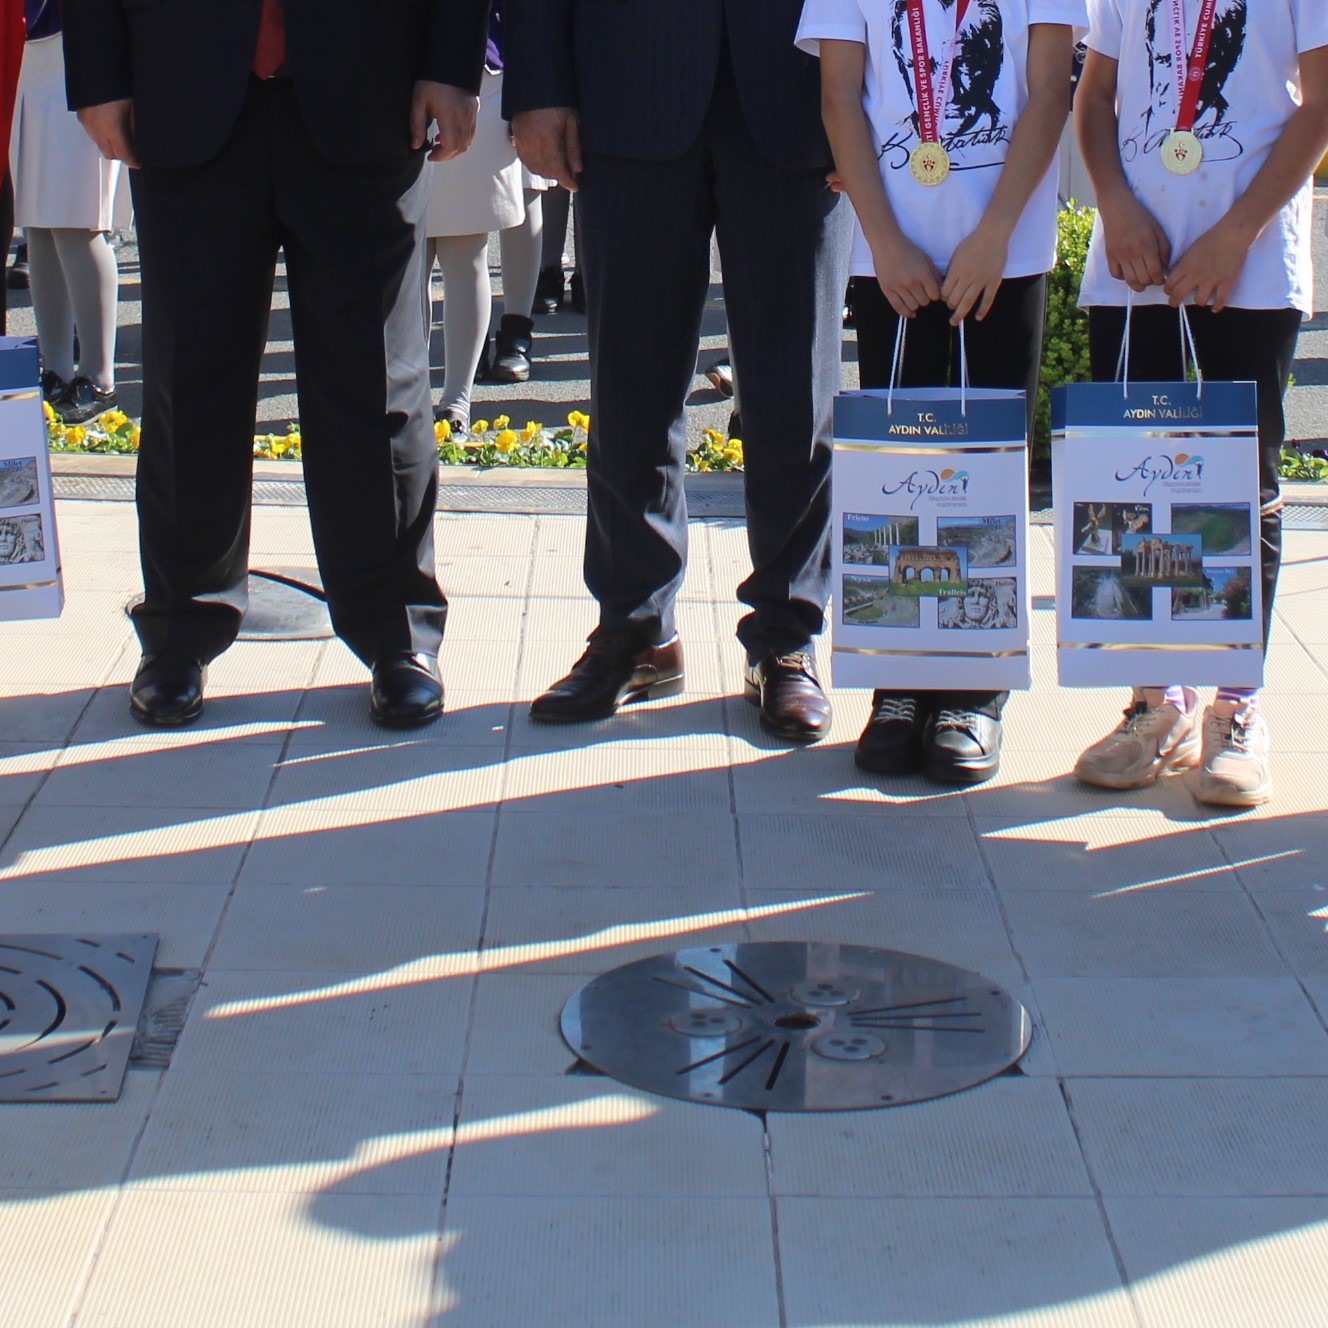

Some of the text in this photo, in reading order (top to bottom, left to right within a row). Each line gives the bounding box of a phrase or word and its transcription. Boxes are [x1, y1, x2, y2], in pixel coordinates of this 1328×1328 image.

[1173, 26, 1182, 37] VE
[1195, 23, 1210, 59] TÜRKİYE
[1174, 38, 1184, 62] SPOR
[910, 7, 933, 128] GENÇLİK VE SPOR BAKANLIĞI
[937, 60, 951, 94] TÜRKİYE
[1152, 395, 1172, 407] T.C.
[917, 412, 937, 423] T.C.
[1123, 406, 1203, 419] AYDIN VALİLİĞİ
[888, 423, 969, 436] AYDIN VALİLİĞİ
[847, 513, 870, 522] Priene
[938, 588, 967, 597] Tralleis
